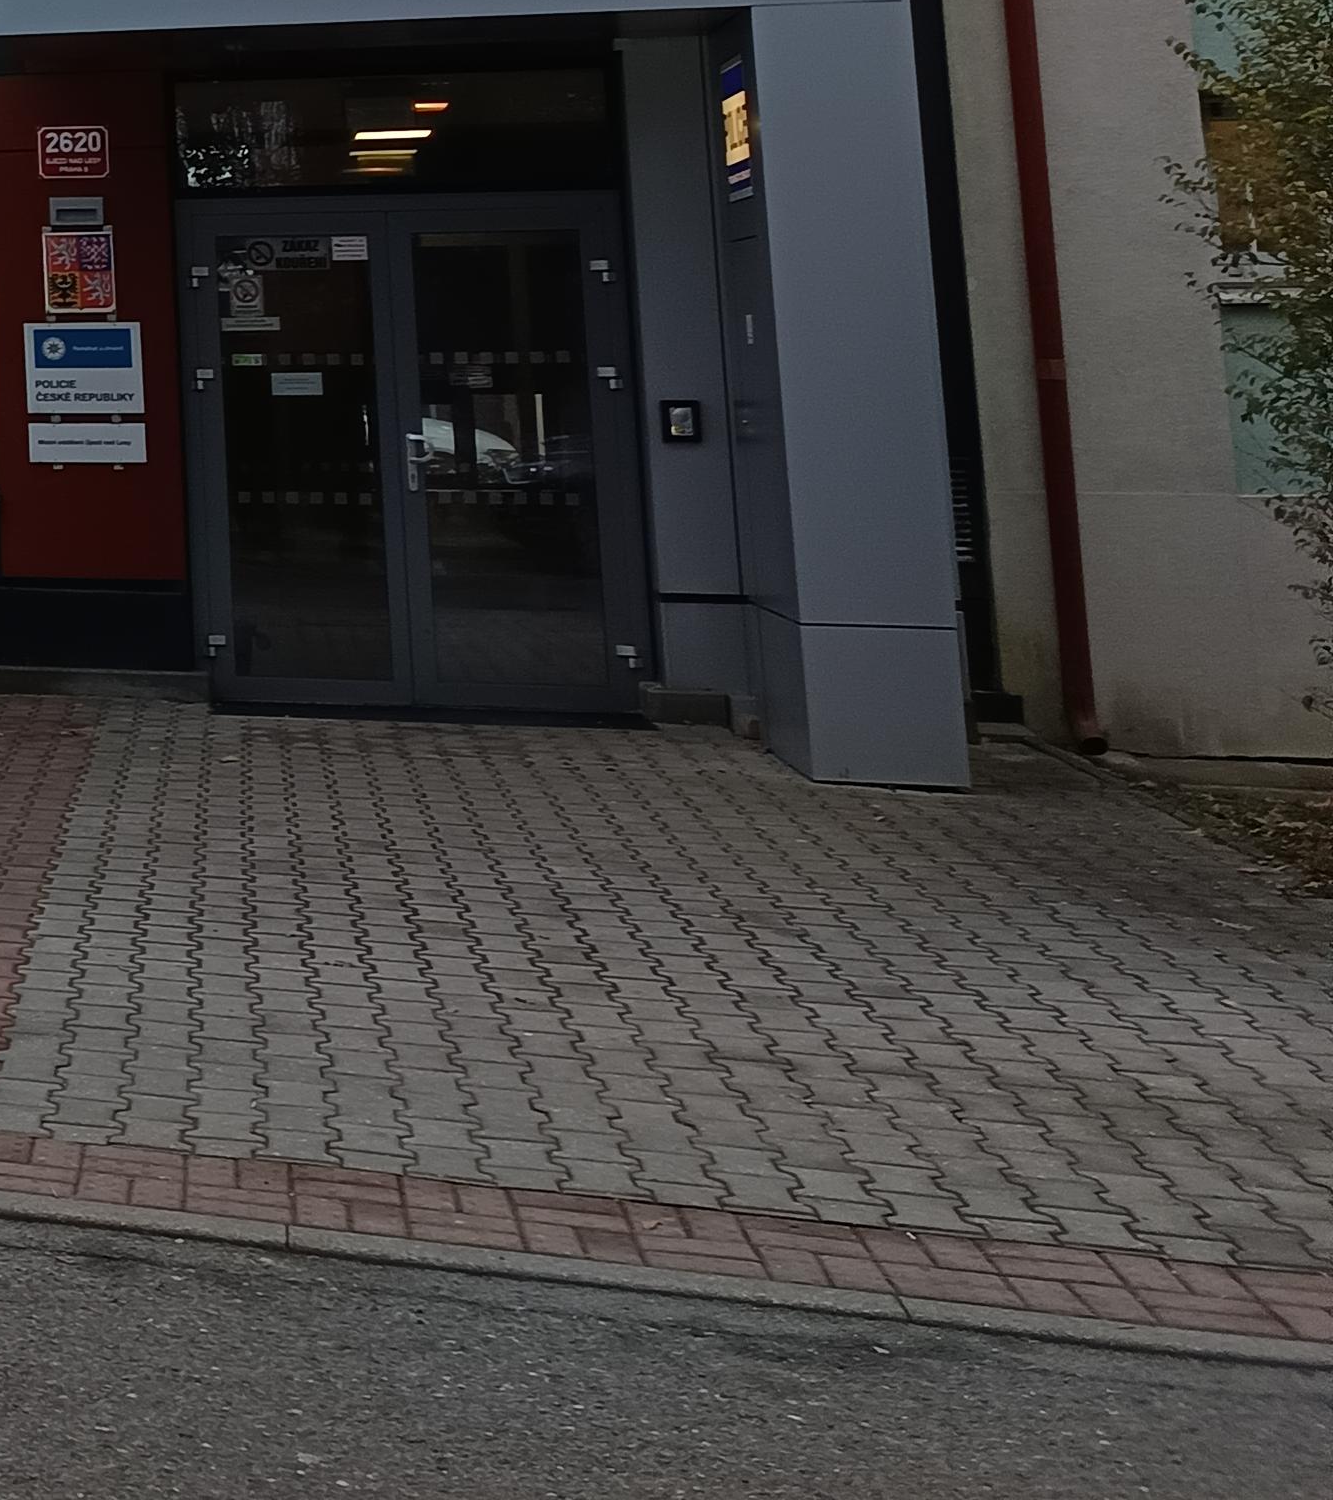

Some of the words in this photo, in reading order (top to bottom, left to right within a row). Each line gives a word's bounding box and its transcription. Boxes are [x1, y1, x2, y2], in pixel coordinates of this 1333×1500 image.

[45, 131, 101, 153] 2620
[35, 380, 76, 388] POLICIE
[36, 391, 72, 402] ČESKÉ
[74, 393, 135, 402] REPUBLIKY
